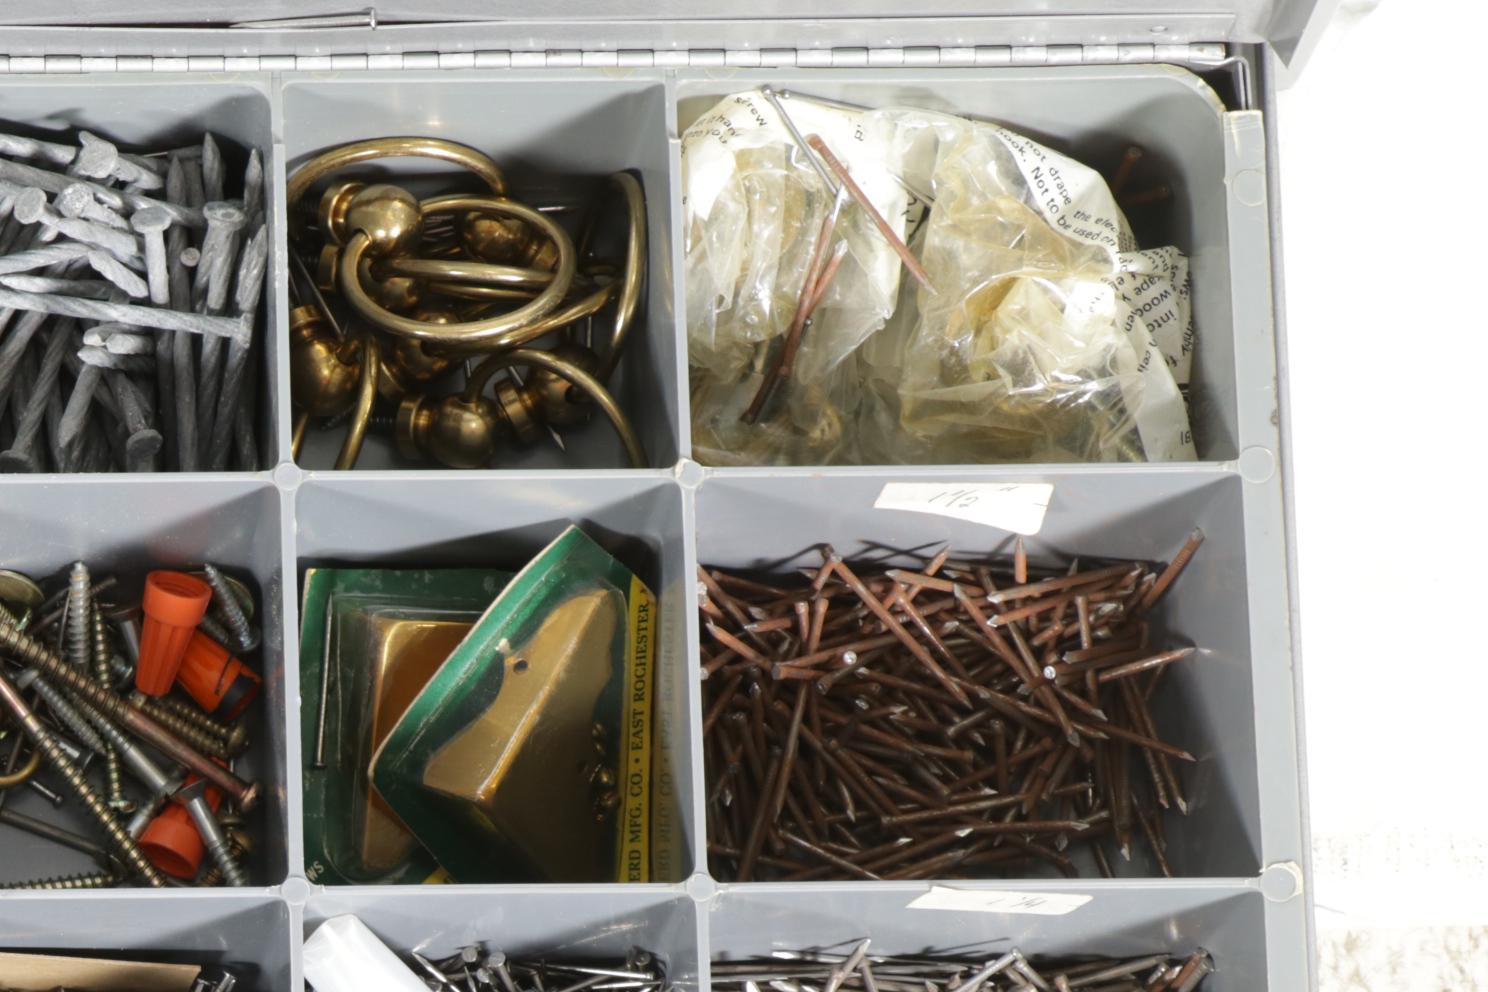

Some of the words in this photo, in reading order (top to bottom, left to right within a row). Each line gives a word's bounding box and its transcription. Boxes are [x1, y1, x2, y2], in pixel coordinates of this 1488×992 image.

[1025, 140, 1047, 162] not
[1049, 167, 1072, 205] drape
[1073, 210, 1093, 223] the
[1031, 166, 1049, 196] Not
[1046, 197, 1060, 214] to
[1057, 215, 1072, 231] be
[1073, 227, 1100, 242] used
[631, 708, 645, 750] EAST
[630, 769, 643, 797] CO.
[629, 802, 642, 843] MFG.
